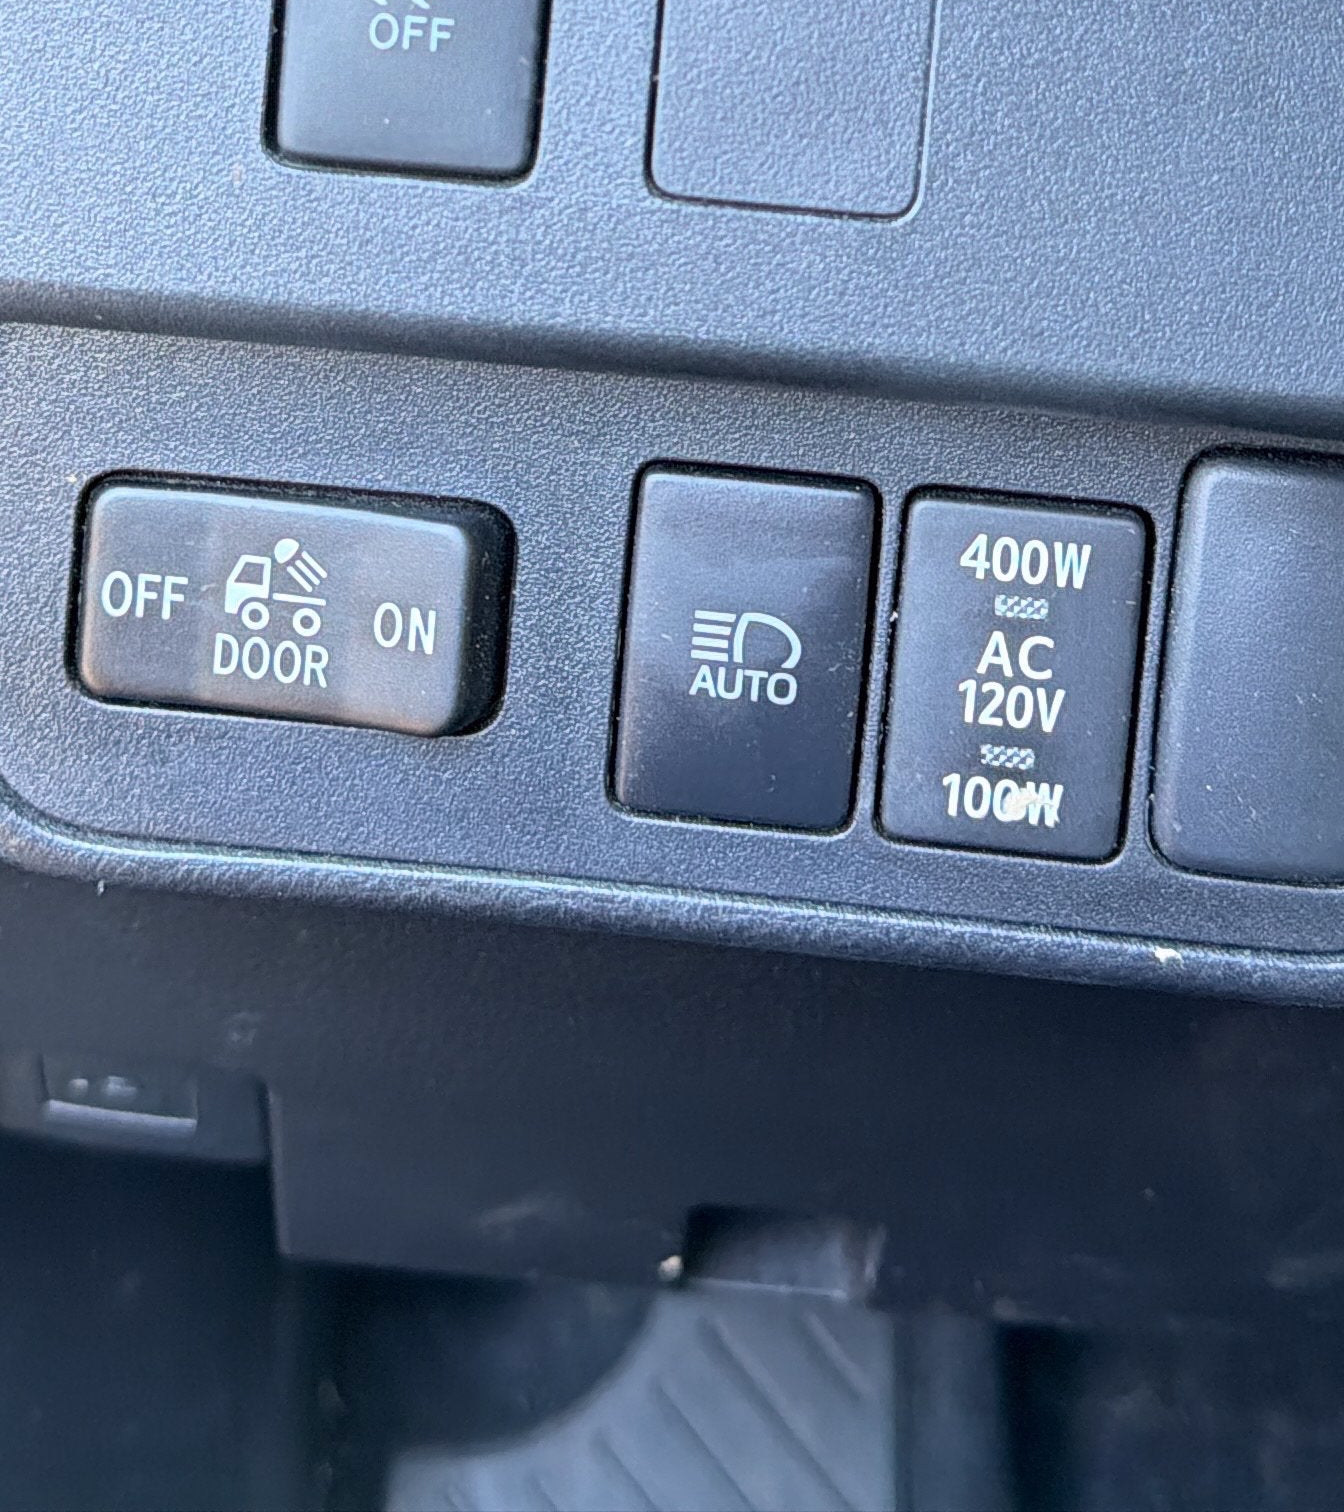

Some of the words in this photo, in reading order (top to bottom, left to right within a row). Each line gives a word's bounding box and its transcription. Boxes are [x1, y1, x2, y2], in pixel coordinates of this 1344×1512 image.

[368, 11, 456, 53] OFF
[959, 533, 1092, 590] 400W
[100, 569, 189, 621] OFF
[372, 601, 437, 655] ON
[975, 630, 1055, 680] AC
[212, 632, 330, 688] DOOR
[688, 663, 798, 706] AUTO
[957, 678, 1066, 734] 120V
[941, 772, 1064, 829] 100W
